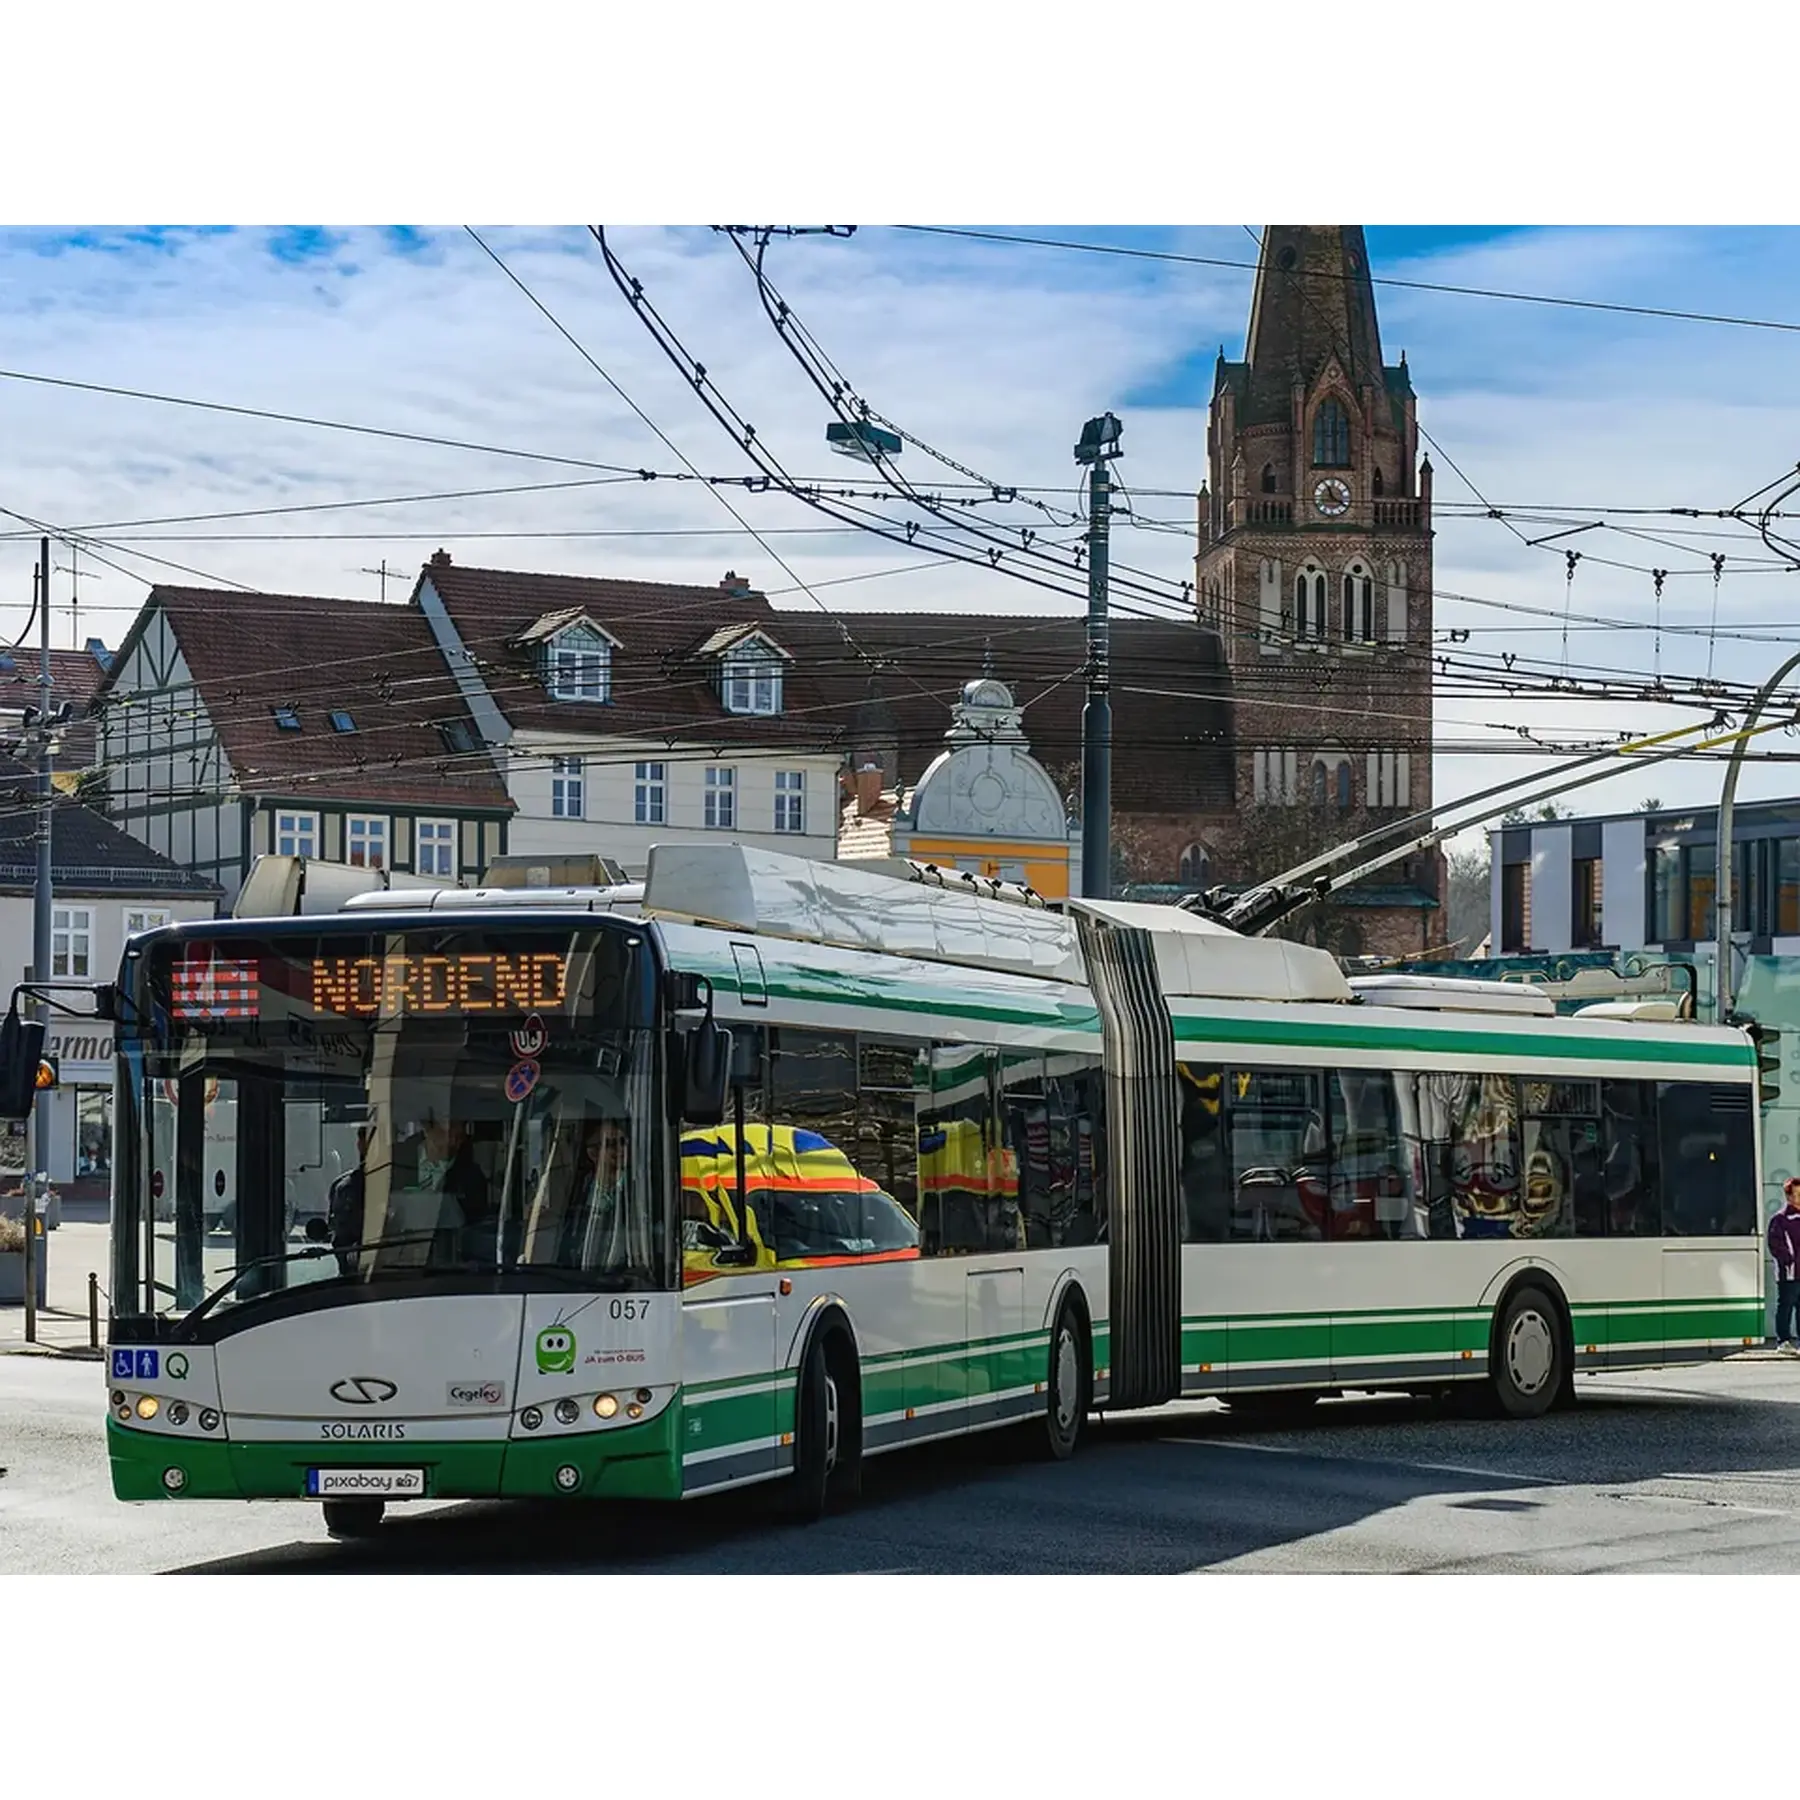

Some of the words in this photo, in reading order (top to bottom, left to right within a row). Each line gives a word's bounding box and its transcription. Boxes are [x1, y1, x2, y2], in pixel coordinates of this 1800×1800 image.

[313, 954, 566, 1012] NORDEND
[610, 1299, 650, 1320] 057
[166, 1352, 189, 1380] Q
[451, 1386, 498, 1402] Cegelec
[321, 1424, 405, 1439] SOLARIS
[323, 1473, 392, 1491] pixabay
